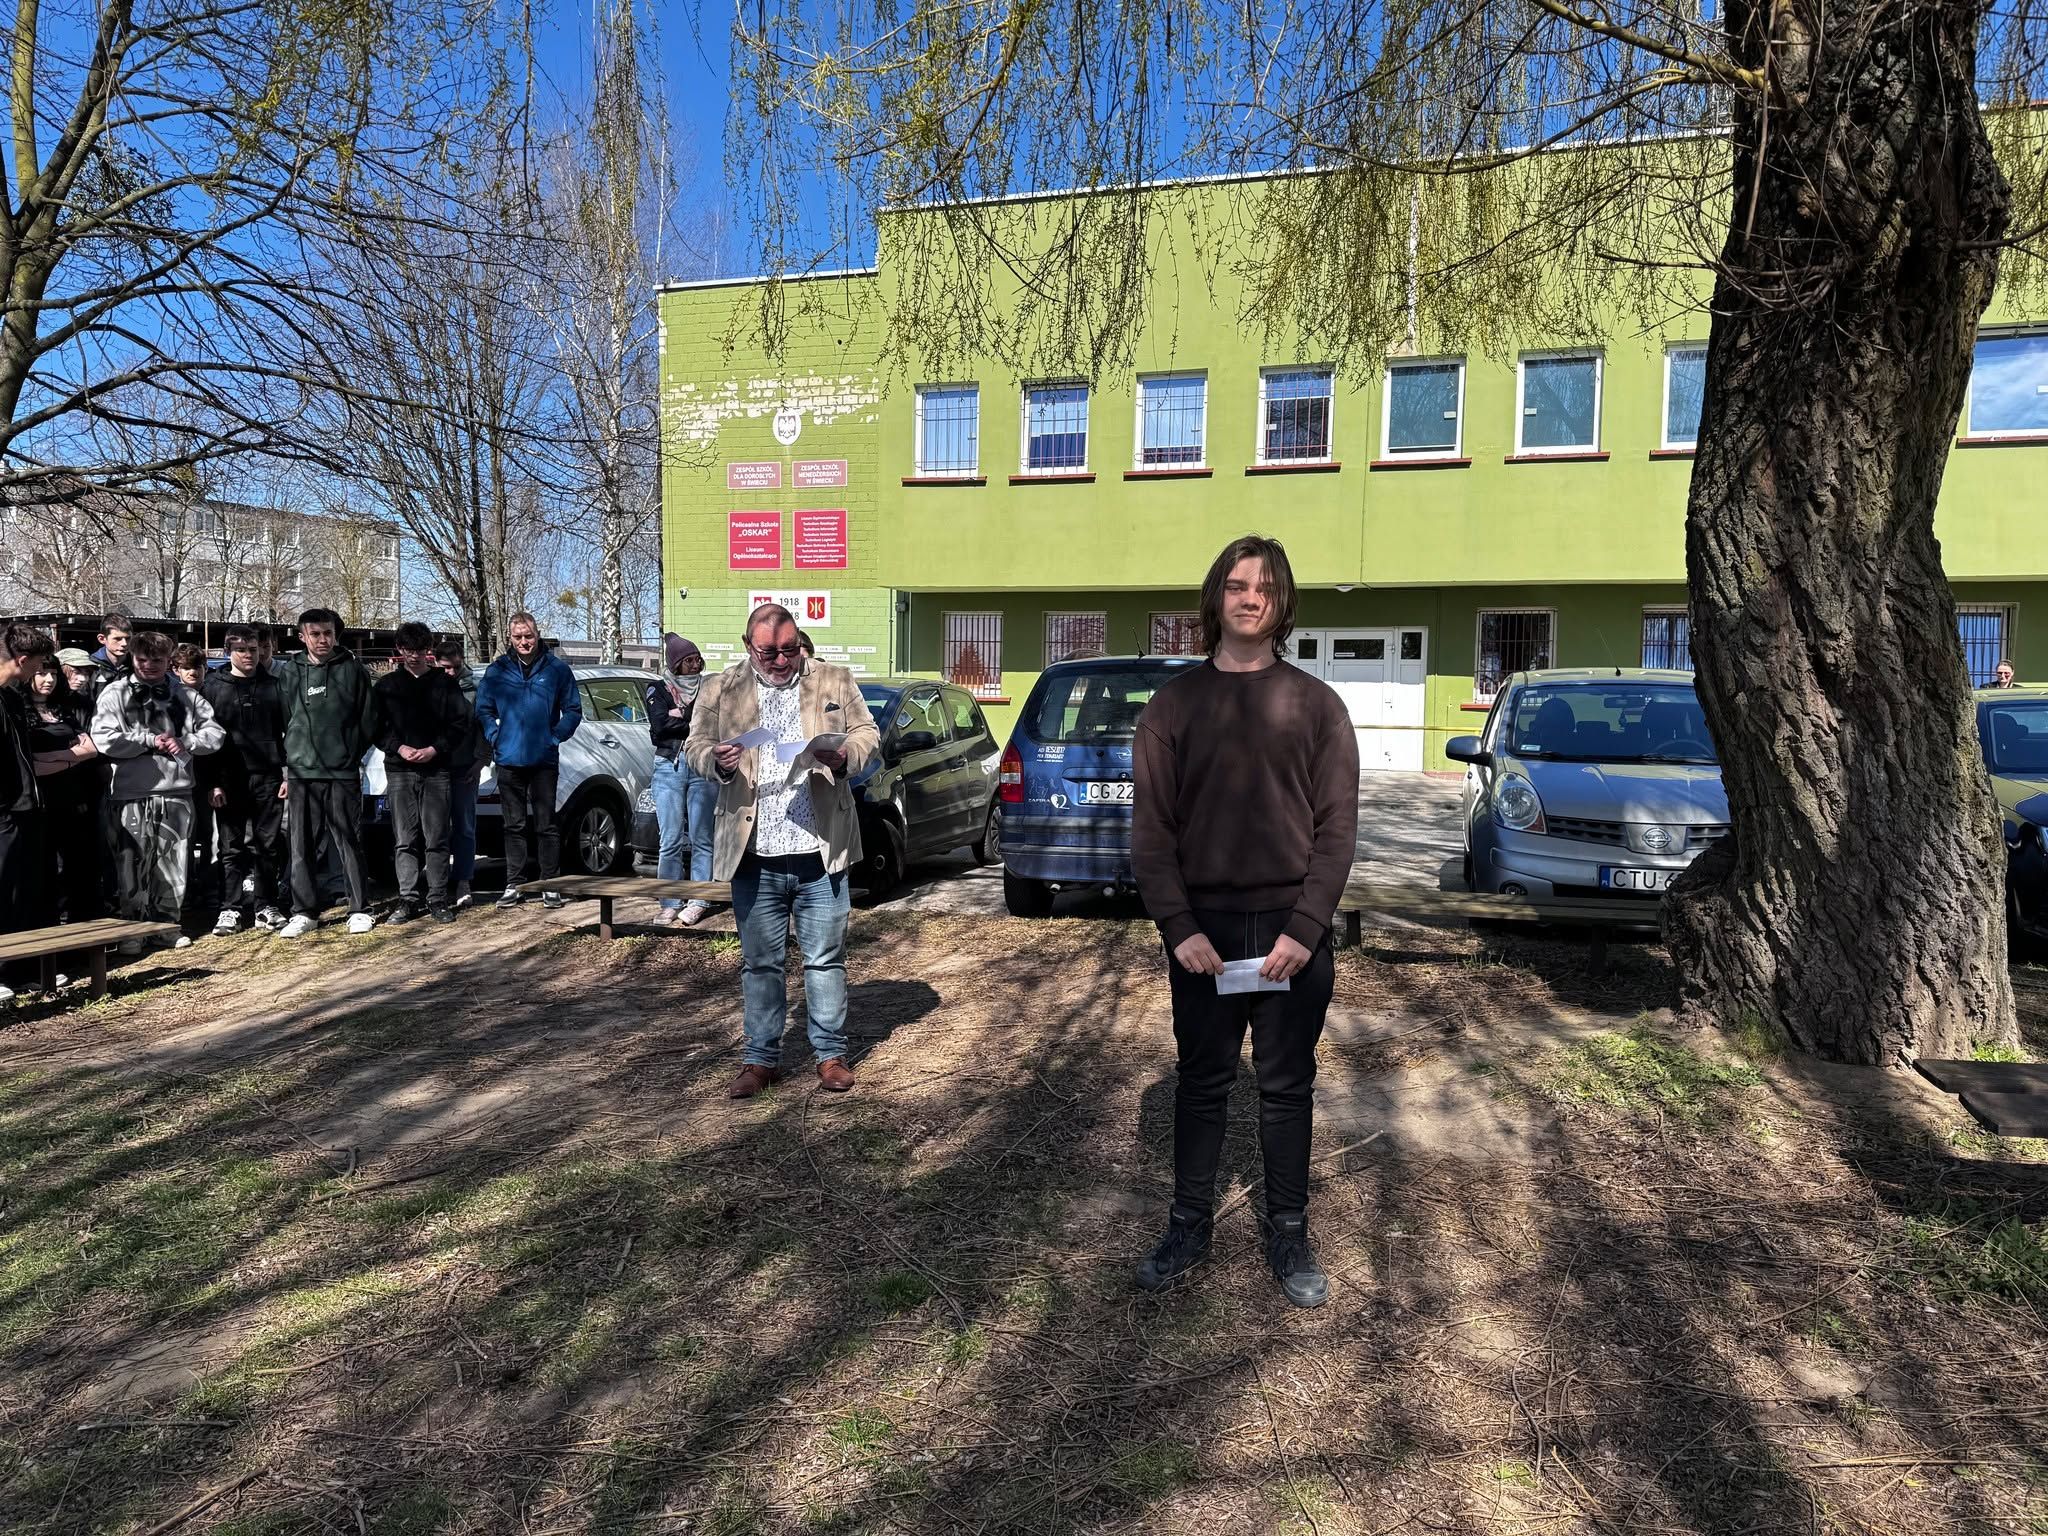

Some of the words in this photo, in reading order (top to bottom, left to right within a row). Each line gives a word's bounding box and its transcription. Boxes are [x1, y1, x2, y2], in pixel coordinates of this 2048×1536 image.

[779, 597, 800, 606] 1918
[1090, 783, 1110, 800] CG
[1613, 869, 1657, 889] CTU
